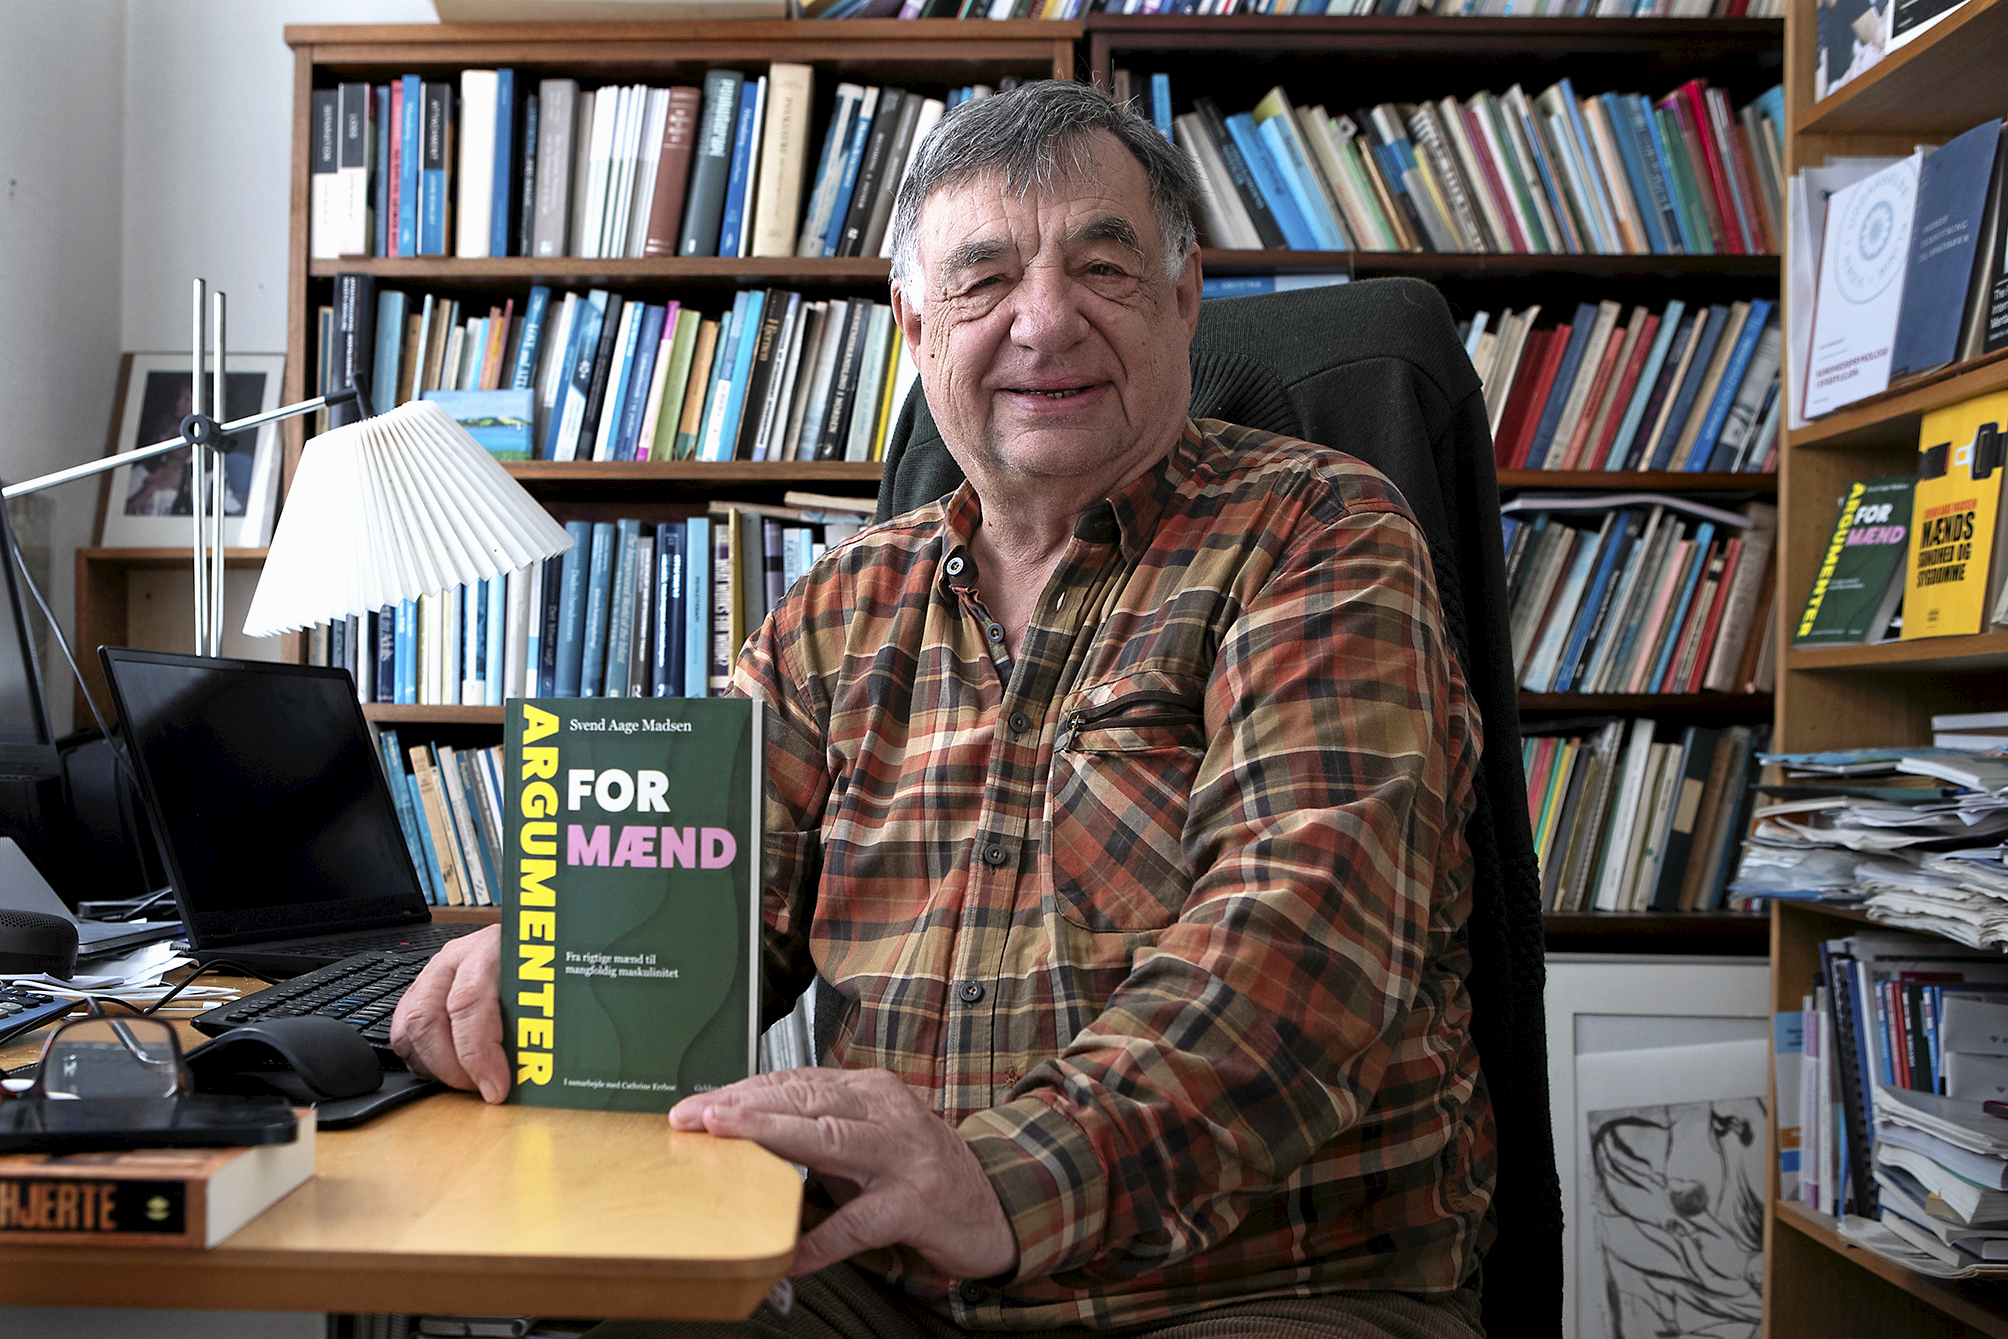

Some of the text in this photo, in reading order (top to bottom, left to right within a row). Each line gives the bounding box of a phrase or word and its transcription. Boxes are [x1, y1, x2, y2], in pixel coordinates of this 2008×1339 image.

[429, 99, 439, 160] ATTACHMENT
[759, 318, 779, 362] Hjernen
[828, 397, 843, 434] NORDEN
[1853, 503, 1893, 525] FOR
[1920, 511, 1975, 549] MÆNDS
[1845, 525, 1906, 547] MÆND
[621, 548, 636, 595] Interpersonal
[1796, 482, 1867, 638] ARGUMENTER
[1917, 542, 1972, 569] SUNDHED OG
[1916, 563, 1967, 588] SYGDOMME
[620, 596, 631, 618] World
[713, 557, 730, 666] WHAT WORKS FOR WHOM?
[569, 719, 692, 734] Svend Aage Madsen
[459, 762, 472, 790] Psykiatri
[568, 769, 671, 813] FOR
[567, 825, 737, 869] MÆND
[516, 703, 560, 1086] ARGUMENTER
[565, 965, 679, 978] mangfoldig maskulinitet
[566, 952, 656, 965] Fra rigtige mænd til
[563, 1078, 567, 1086] I
[569, 1078, 604, 1089] samarbejde
[606, 1081, 620, 1089] med
[621, 1082, 650, 1091] Cathrine
[0, 1182, 117, 1230] HJERTE
